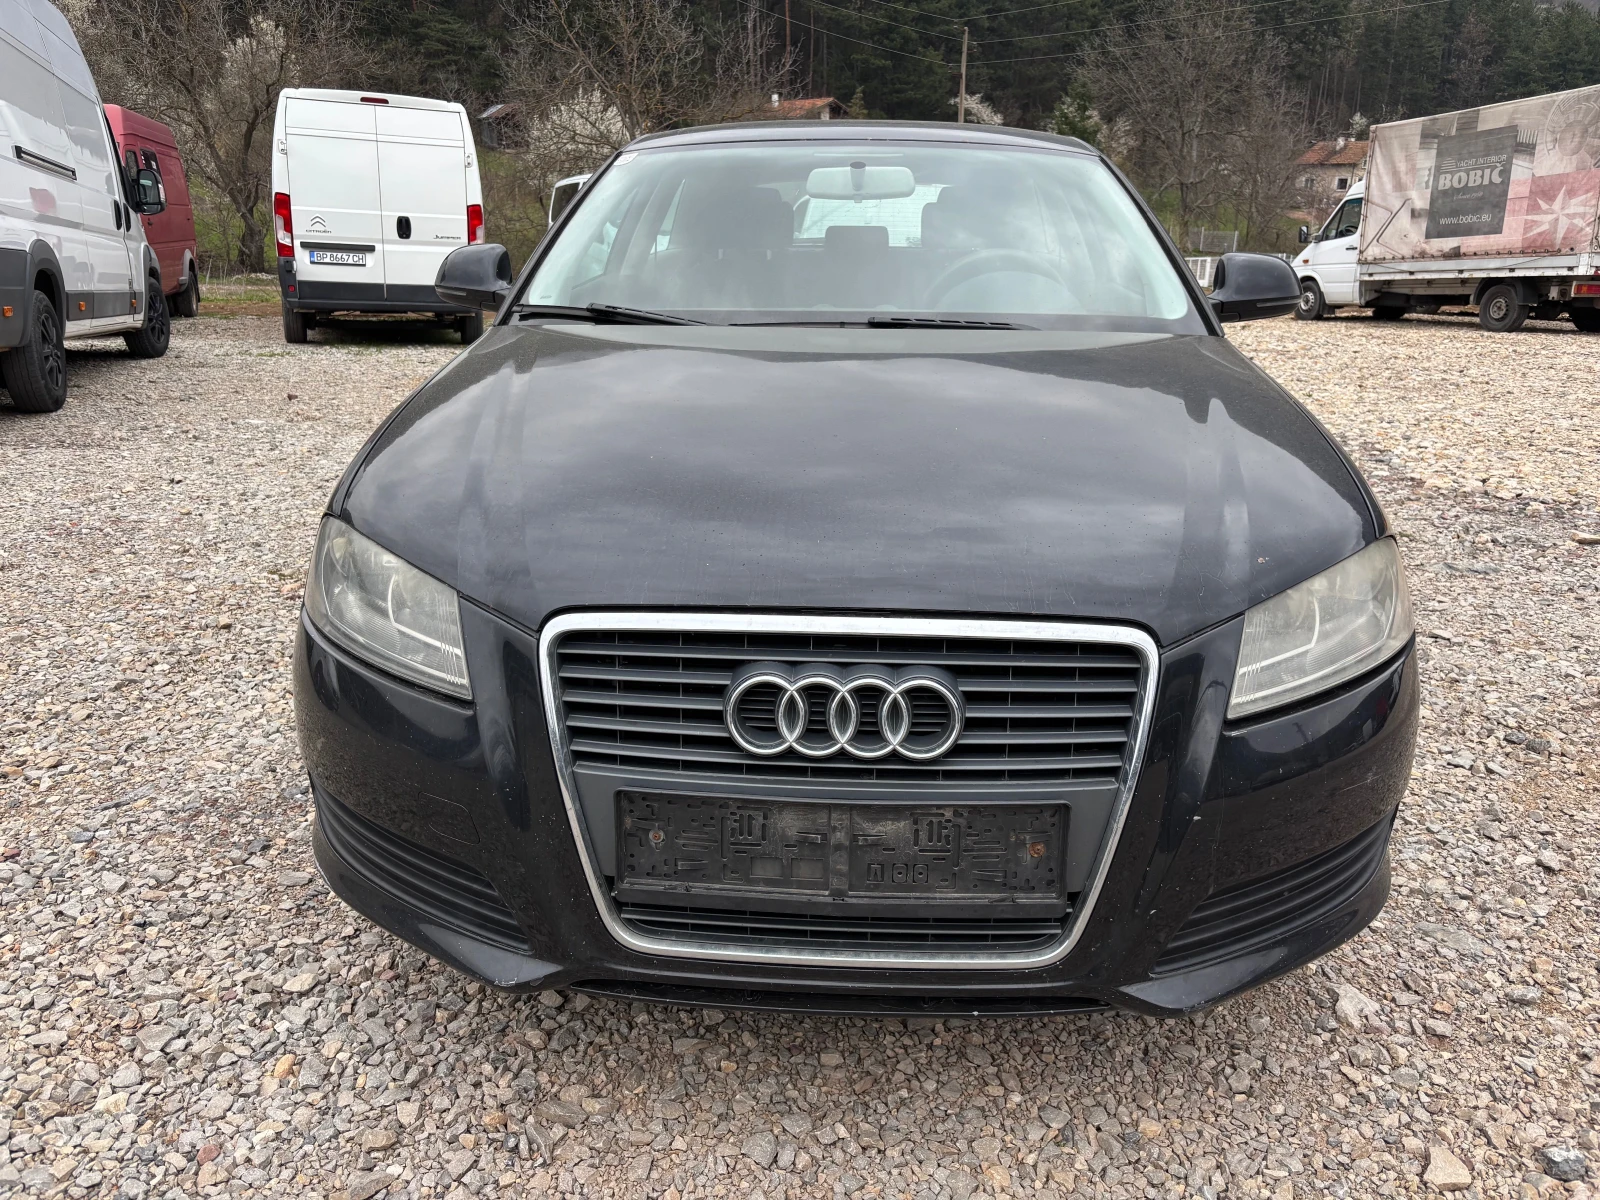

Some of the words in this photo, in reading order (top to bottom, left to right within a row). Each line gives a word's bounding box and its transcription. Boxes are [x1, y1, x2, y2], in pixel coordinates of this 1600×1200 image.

[1456, 158, 1477, 168] YACHT
[1477, 154, 1507, 165] INTERIOR
[1437, 163, 1504, 190] BOBIČ
[1439, 213, 1492, 225] www.bobic.eu
[315, 252, 328, 262] BP
[329, 253, 351, 263] 8667
[351, 254, 364, 264] CH
